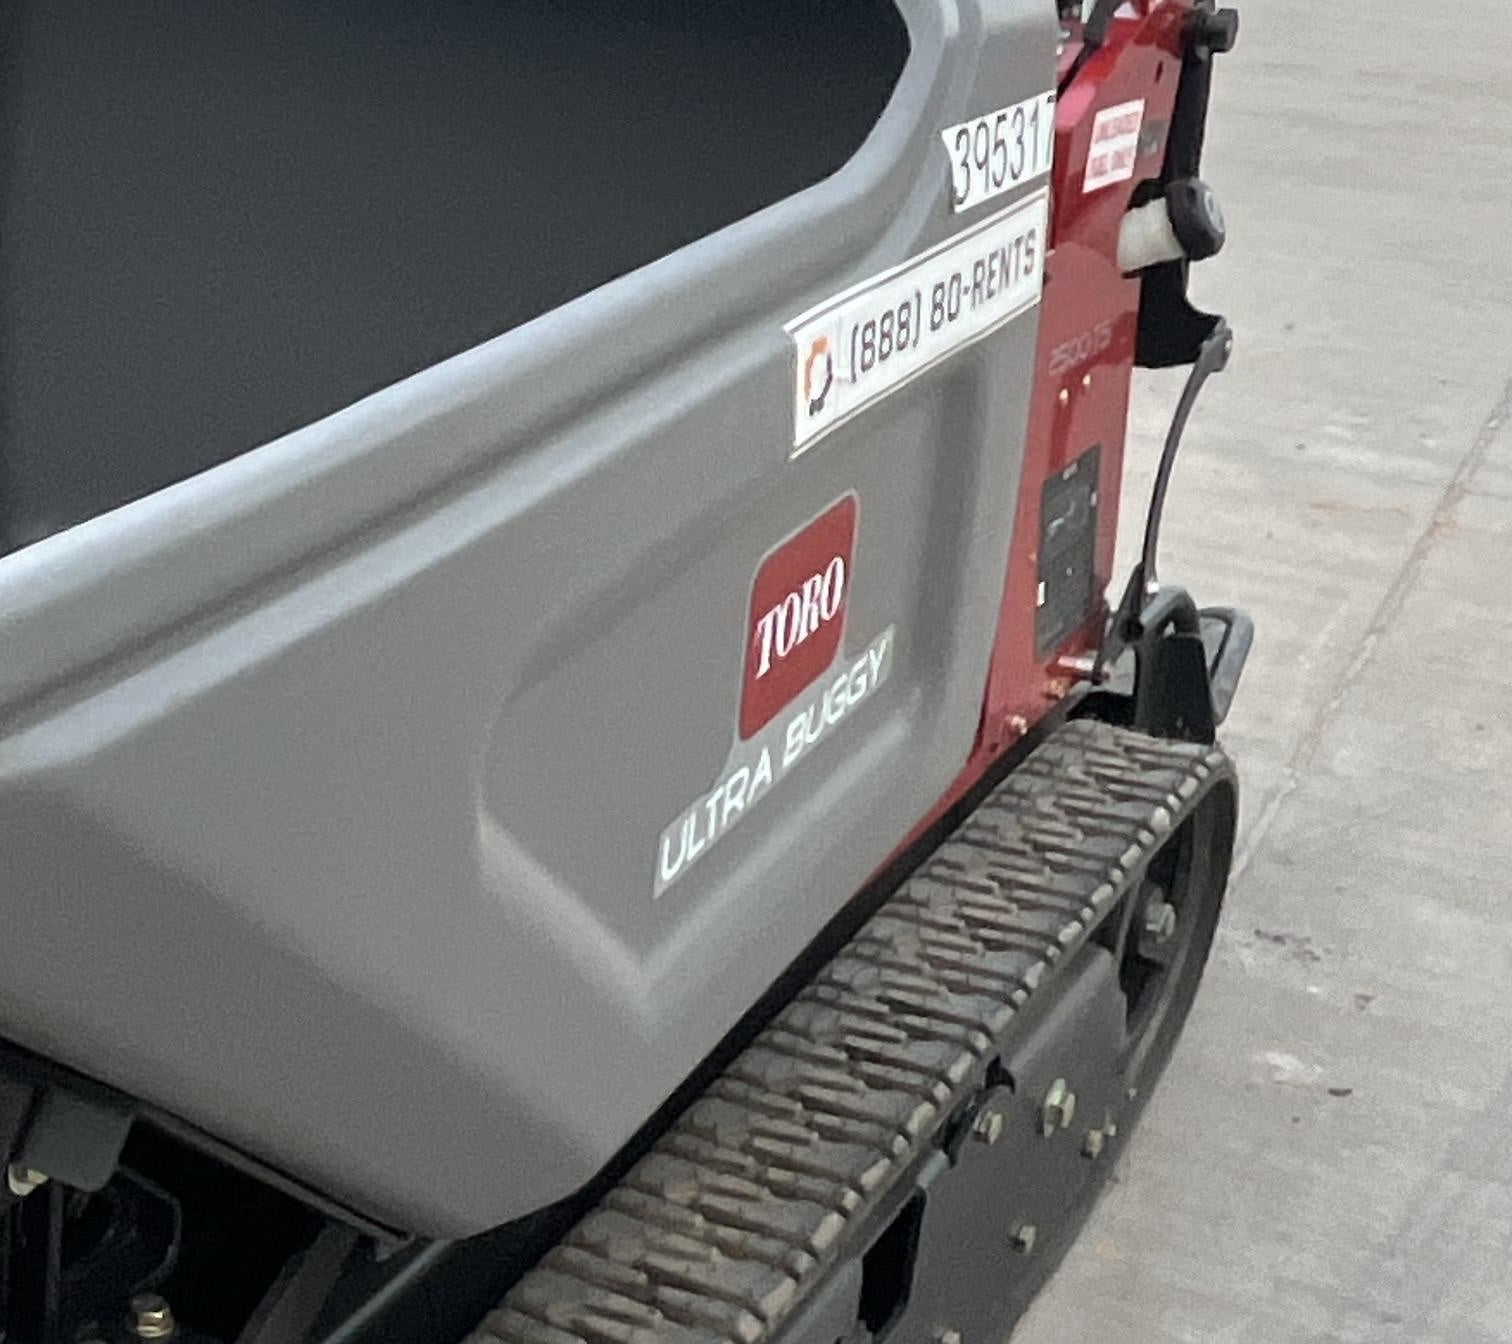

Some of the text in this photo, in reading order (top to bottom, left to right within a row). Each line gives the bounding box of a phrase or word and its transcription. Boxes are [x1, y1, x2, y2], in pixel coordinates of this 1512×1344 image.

[850, 227, 1037, 386] (888) 80-RENTS
[753, 555, 846, 681] TORO
[659, 636, 889, 883] ULTRA BUGGY
